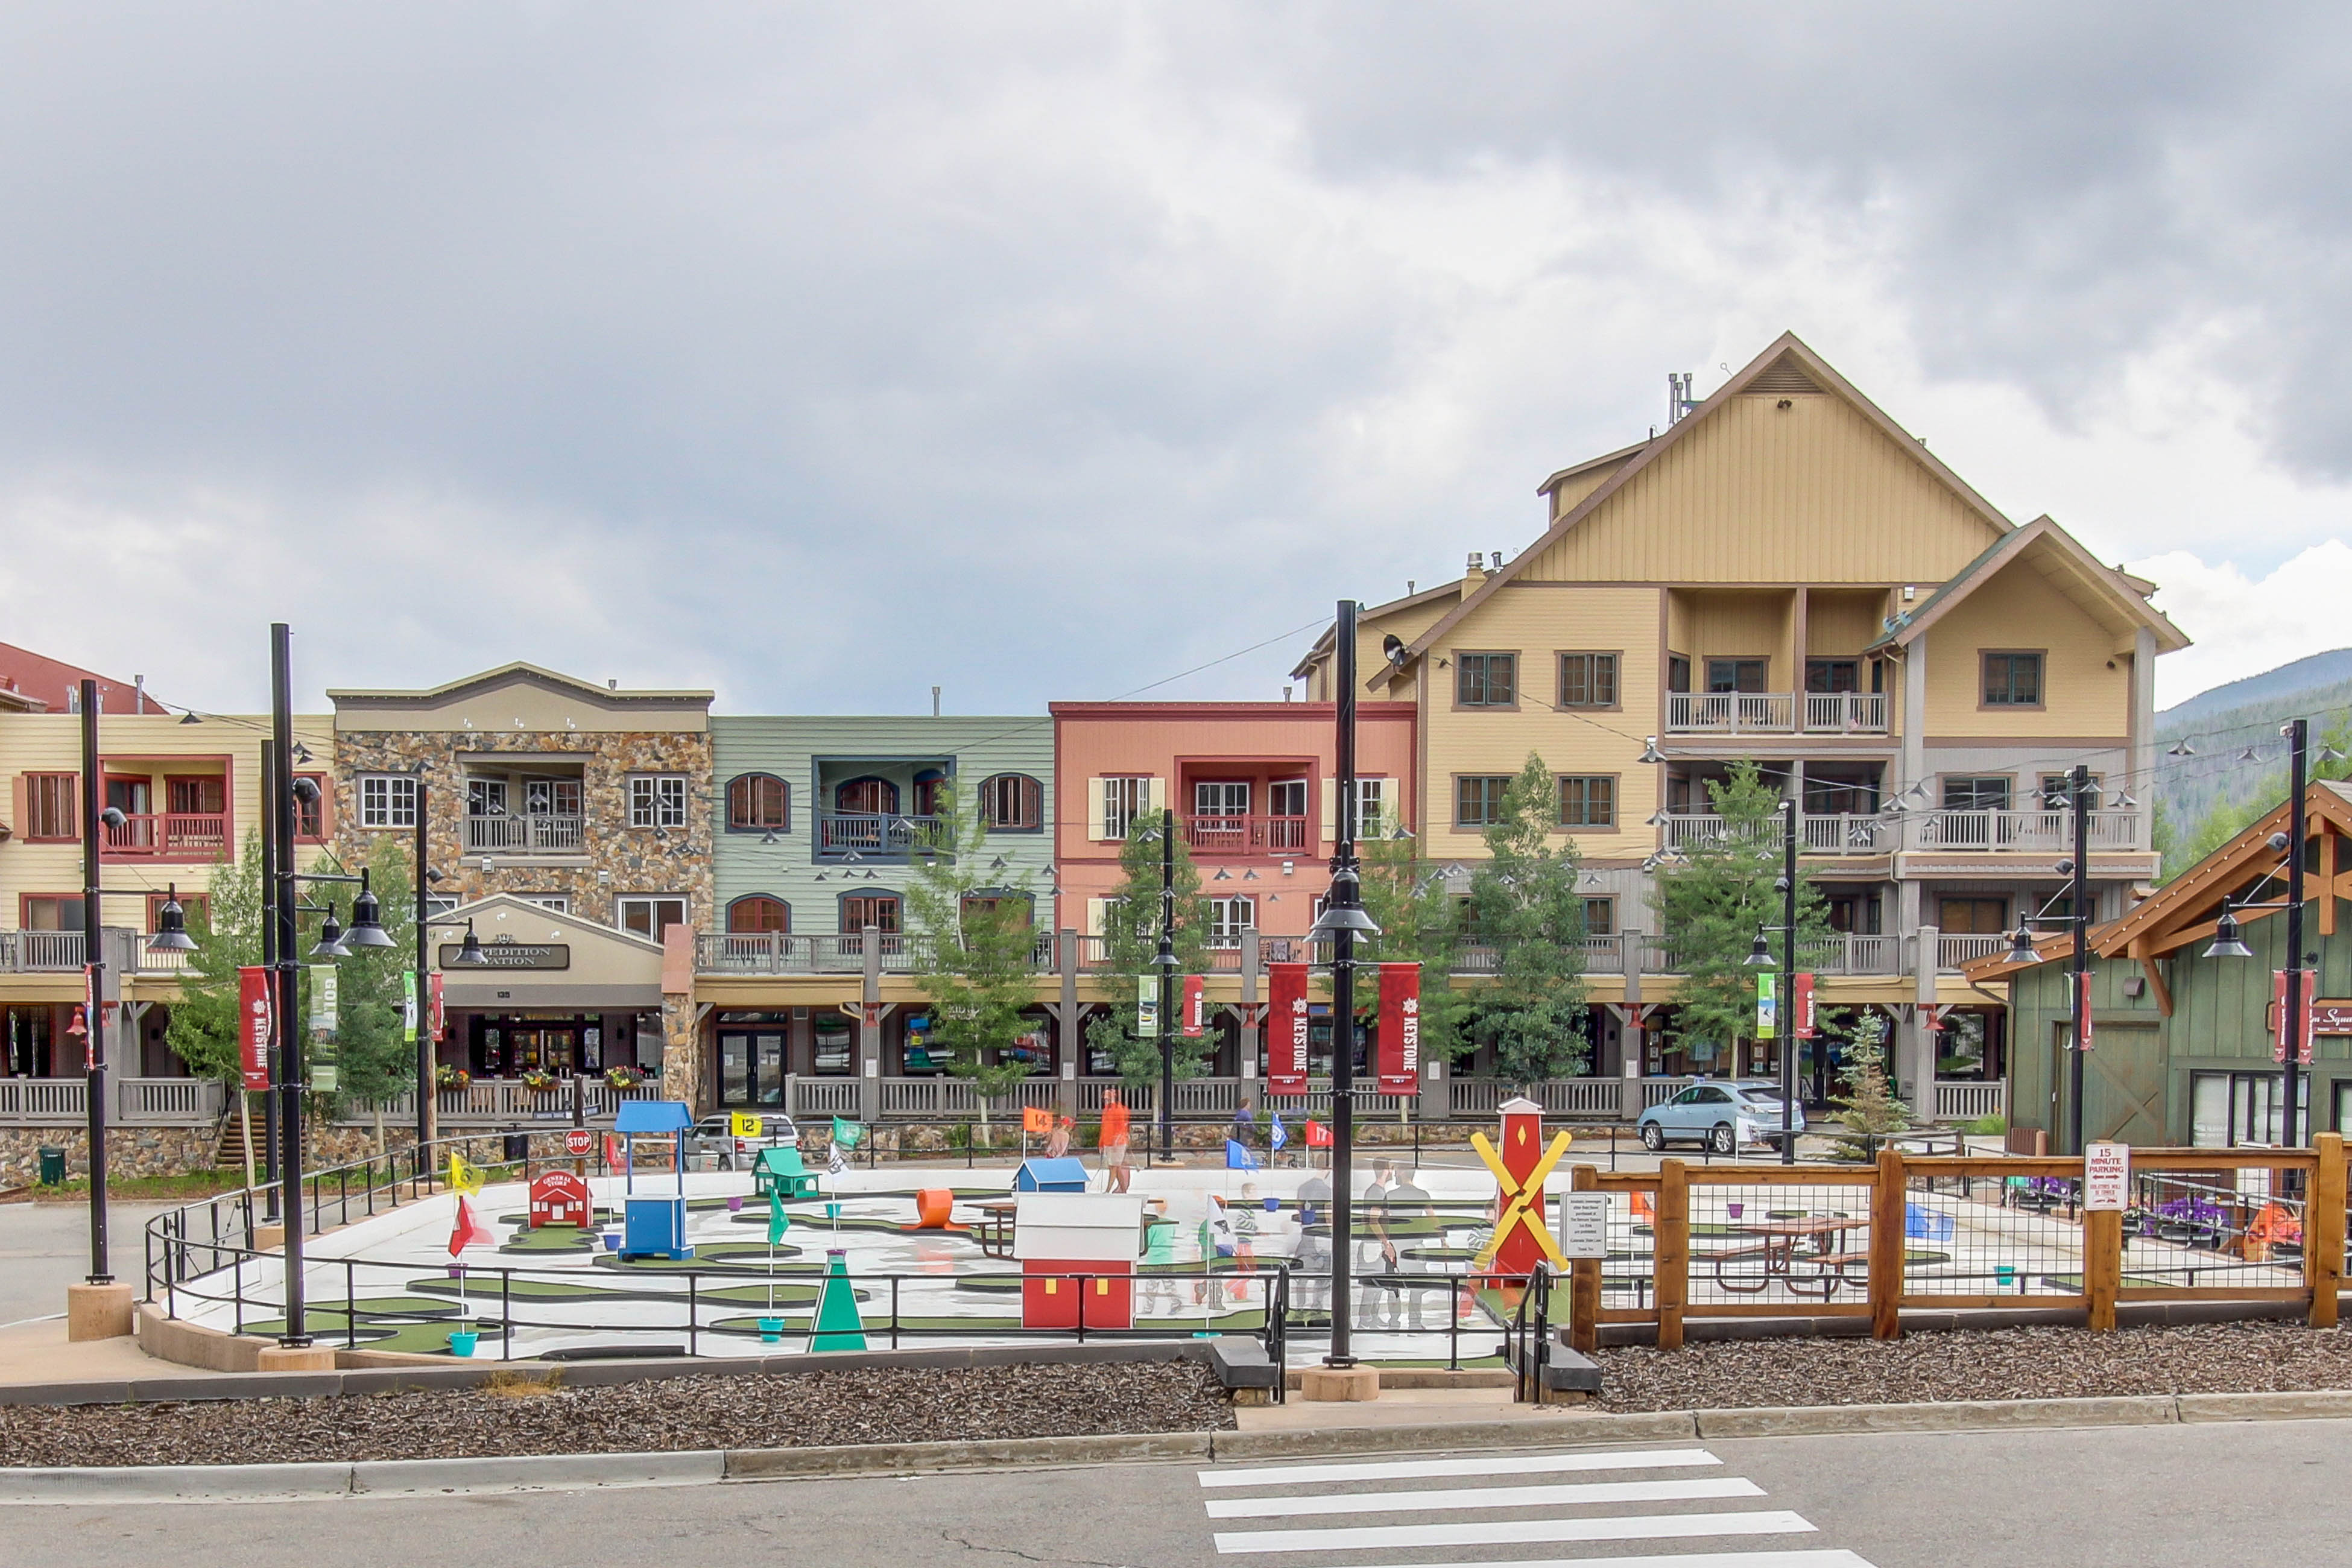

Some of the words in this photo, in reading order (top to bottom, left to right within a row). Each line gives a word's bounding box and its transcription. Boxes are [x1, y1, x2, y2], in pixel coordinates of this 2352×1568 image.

[253, 1017, 268, 1068] KEYSTONE
[1293, 1017, 1307, 1072] KEYSTONE
[1403, 1017, 1418, 1072] KEYSTONE
[742, 1119, 754, 1132] 12
[1035, 1114, 1048, 1127] 14
[567, 1136, 590, 1148] STOP
[2099, 1148, 2111, 1157] 15
